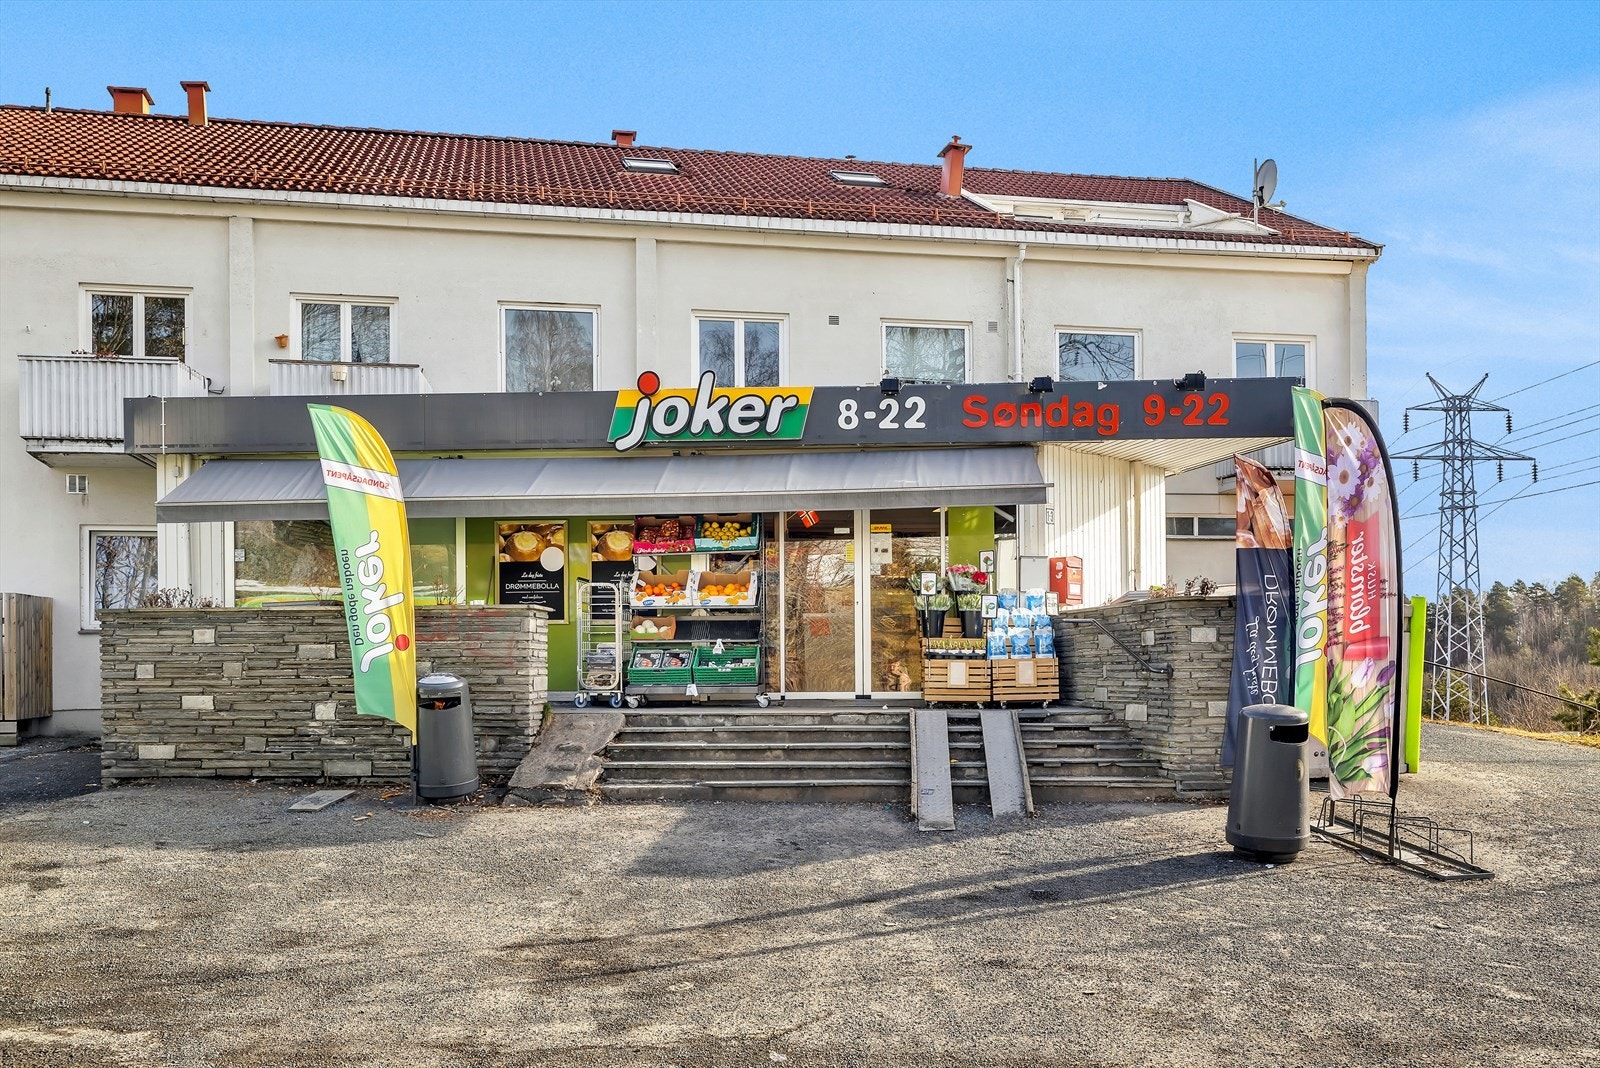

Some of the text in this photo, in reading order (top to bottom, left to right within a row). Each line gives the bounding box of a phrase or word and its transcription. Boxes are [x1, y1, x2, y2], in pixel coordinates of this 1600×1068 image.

[614, 370, 799, 452] joker
[836, 392, 1231, 435] 8-22 Søndag 9-22
[505, 582, 560, 590] DRØMMEBOLLA
